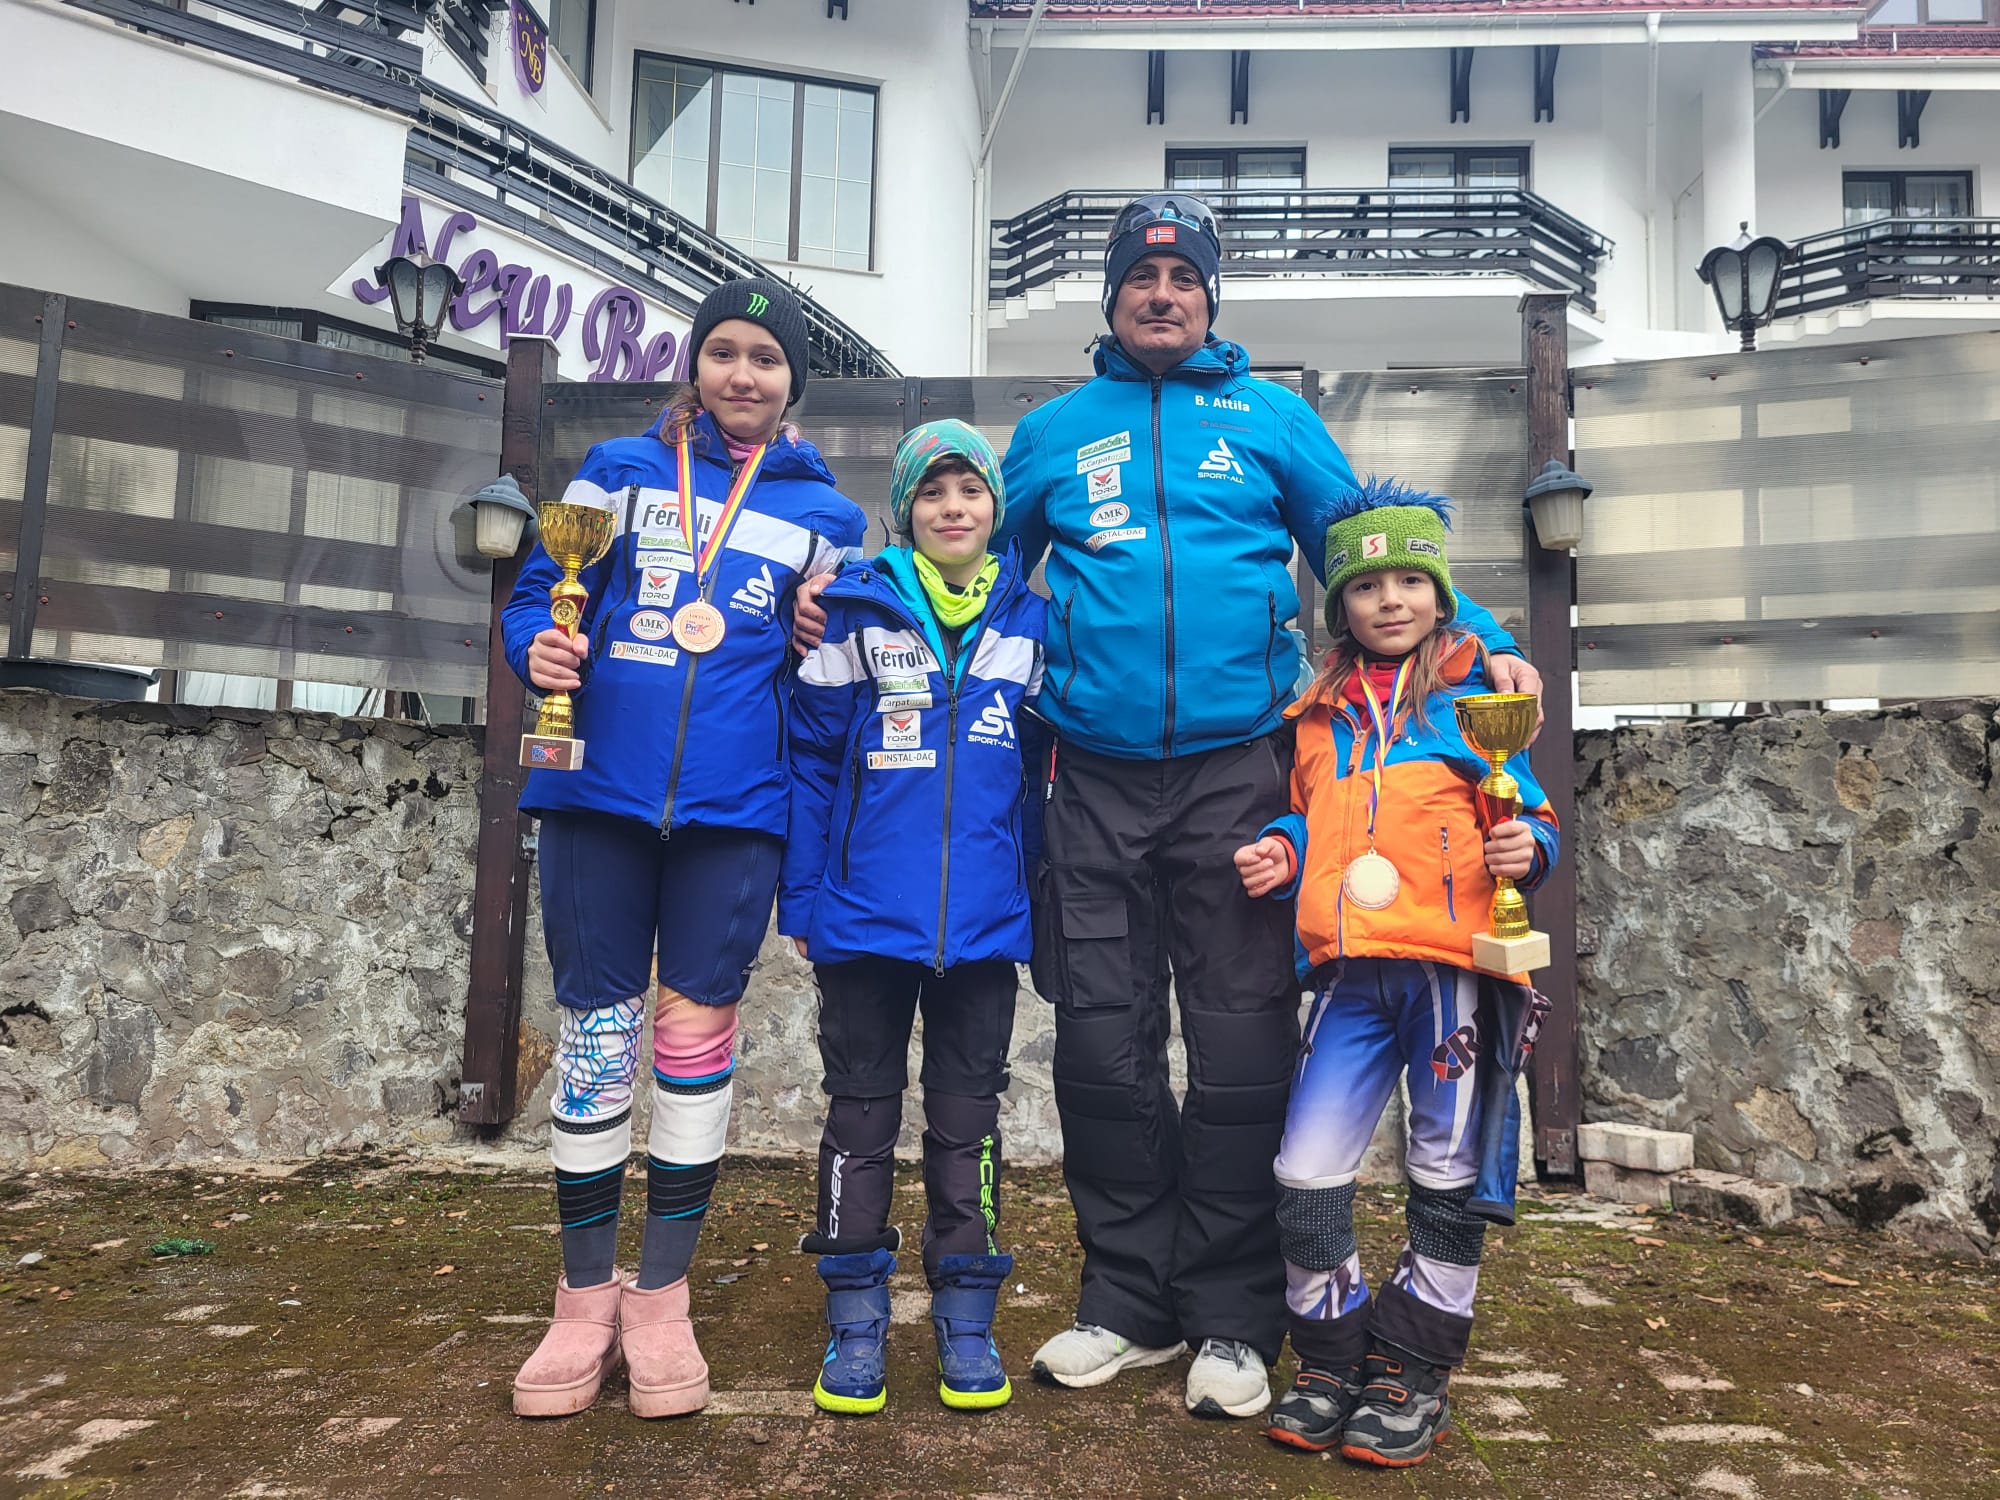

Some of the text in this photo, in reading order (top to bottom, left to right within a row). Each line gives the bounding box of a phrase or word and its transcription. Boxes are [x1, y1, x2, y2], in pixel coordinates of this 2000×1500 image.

[352, 196, 690, 382] New Be
[1194, 394, 1250, 413] B. Attila
[1197, 471, 1245, 485] SPORT-ALL
[1091, 484, 1118, 498] TORO
[642, 503, 712, 535] Ferrli
[1096, 507, 1124, 522] AMK
[1095, 528, 1145, 543] INSTAL-DAC
[641, 591, 670, 601] TORO
[729, 601, 771, 624] SPORT-A
[636, 617, 665, 631] AMK
[626, 643, 676, 660] INSTAL-DAC
[870, 644, 929, 673] Ferroli
[886, 734, 917, 743] TORO
[967, 734, 1015, 750] SPORT-ALL
[884, 752, 935, 763] INSTAL-DAC
